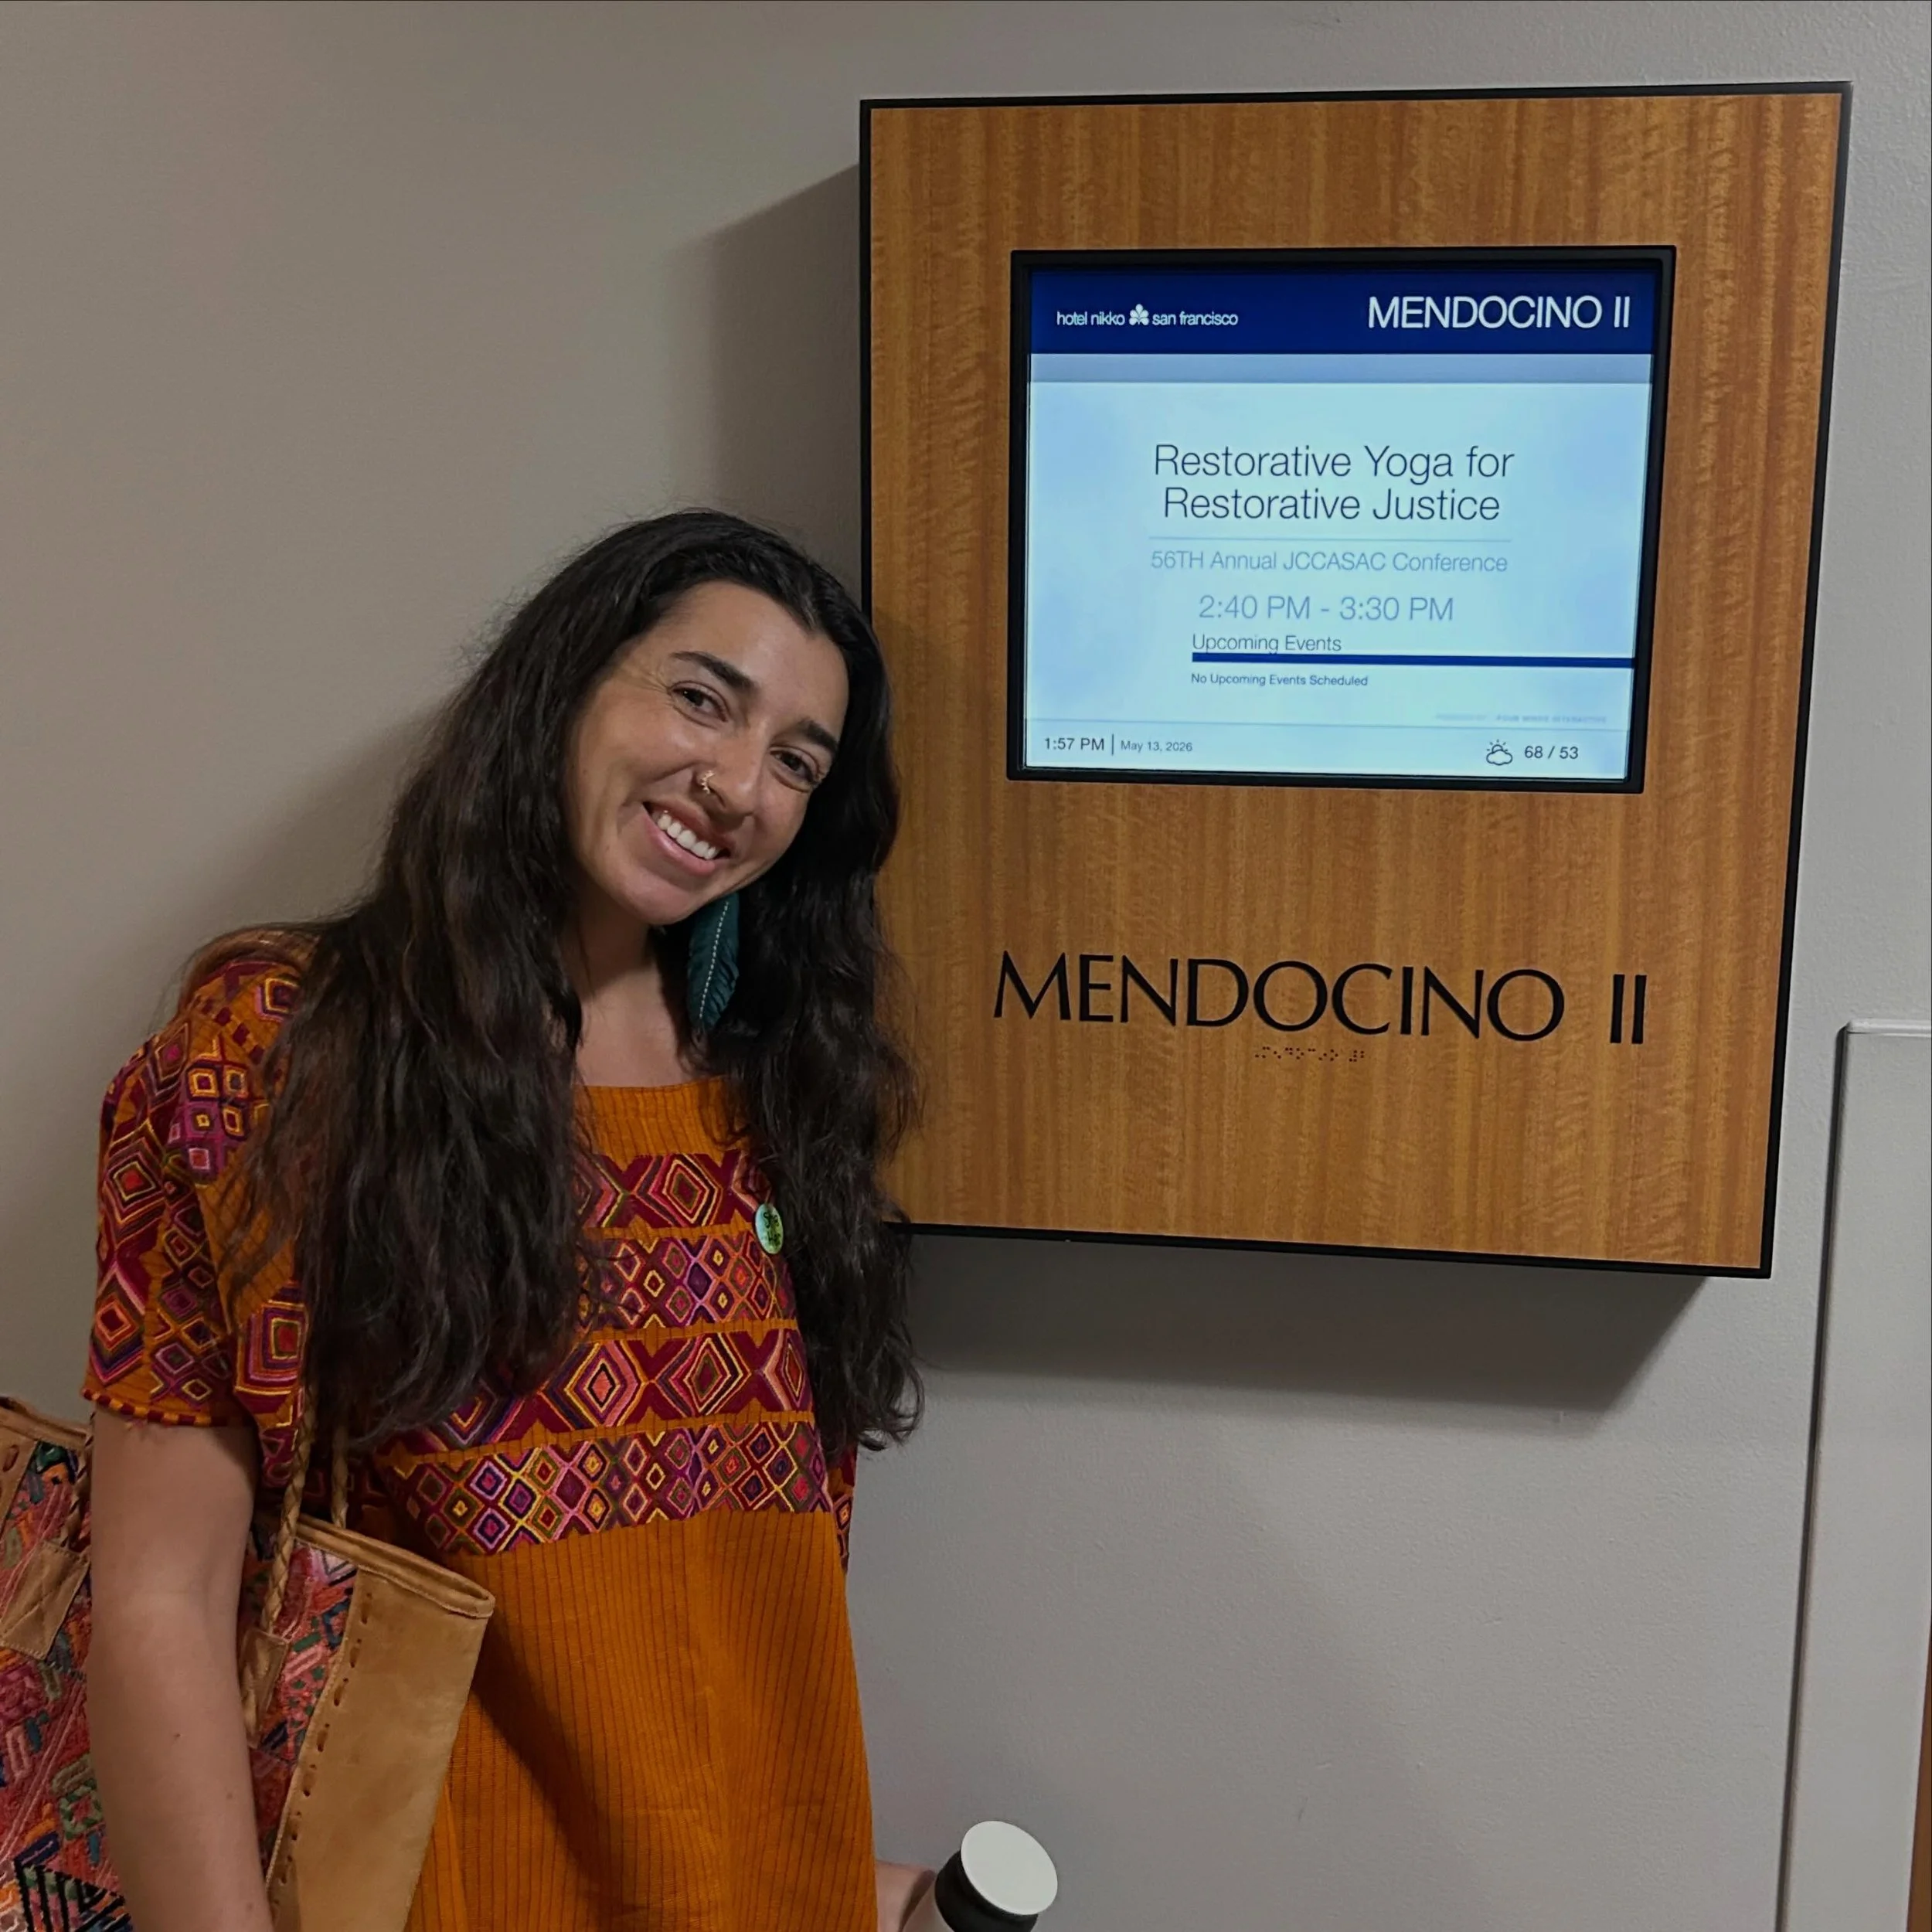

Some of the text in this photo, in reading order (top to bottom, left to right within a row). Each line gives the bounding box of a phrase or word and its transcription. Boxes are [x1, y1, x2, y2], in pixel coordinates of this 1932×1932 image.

[1056, 311, 1239, 326] hotel nikko san francisco
[1368, 295, 1631, 329] MENDOCINO II
[1155, 444, 1515, 486] Restorative Yoga for
[1165, 486, 1500, 522] Restorative Justice
[1151, 549, 1509, 573] 56TH Annual JCCASAC Conference
[1199, 594, 1258, 620] 2:40
[1267, 595, 1311, 621] PM
[1339, 596, 1400, 621] 3:30
[1409, 597, 1454, 622] PM
[1192, 633, 1342, 654] Upcoming Events
[1191, 672, 1369, 687] No Upcoming Events Scheduled
[1044, 737, 1105, 751] 1:57 PM
[1121, 740, 1193, 753] May 13, 2026
[1524, 745, 1543, 759] 68
[1559, 746, 1579, 760] 53
[993, 950, 1648, 1045] MENDOCINO II
